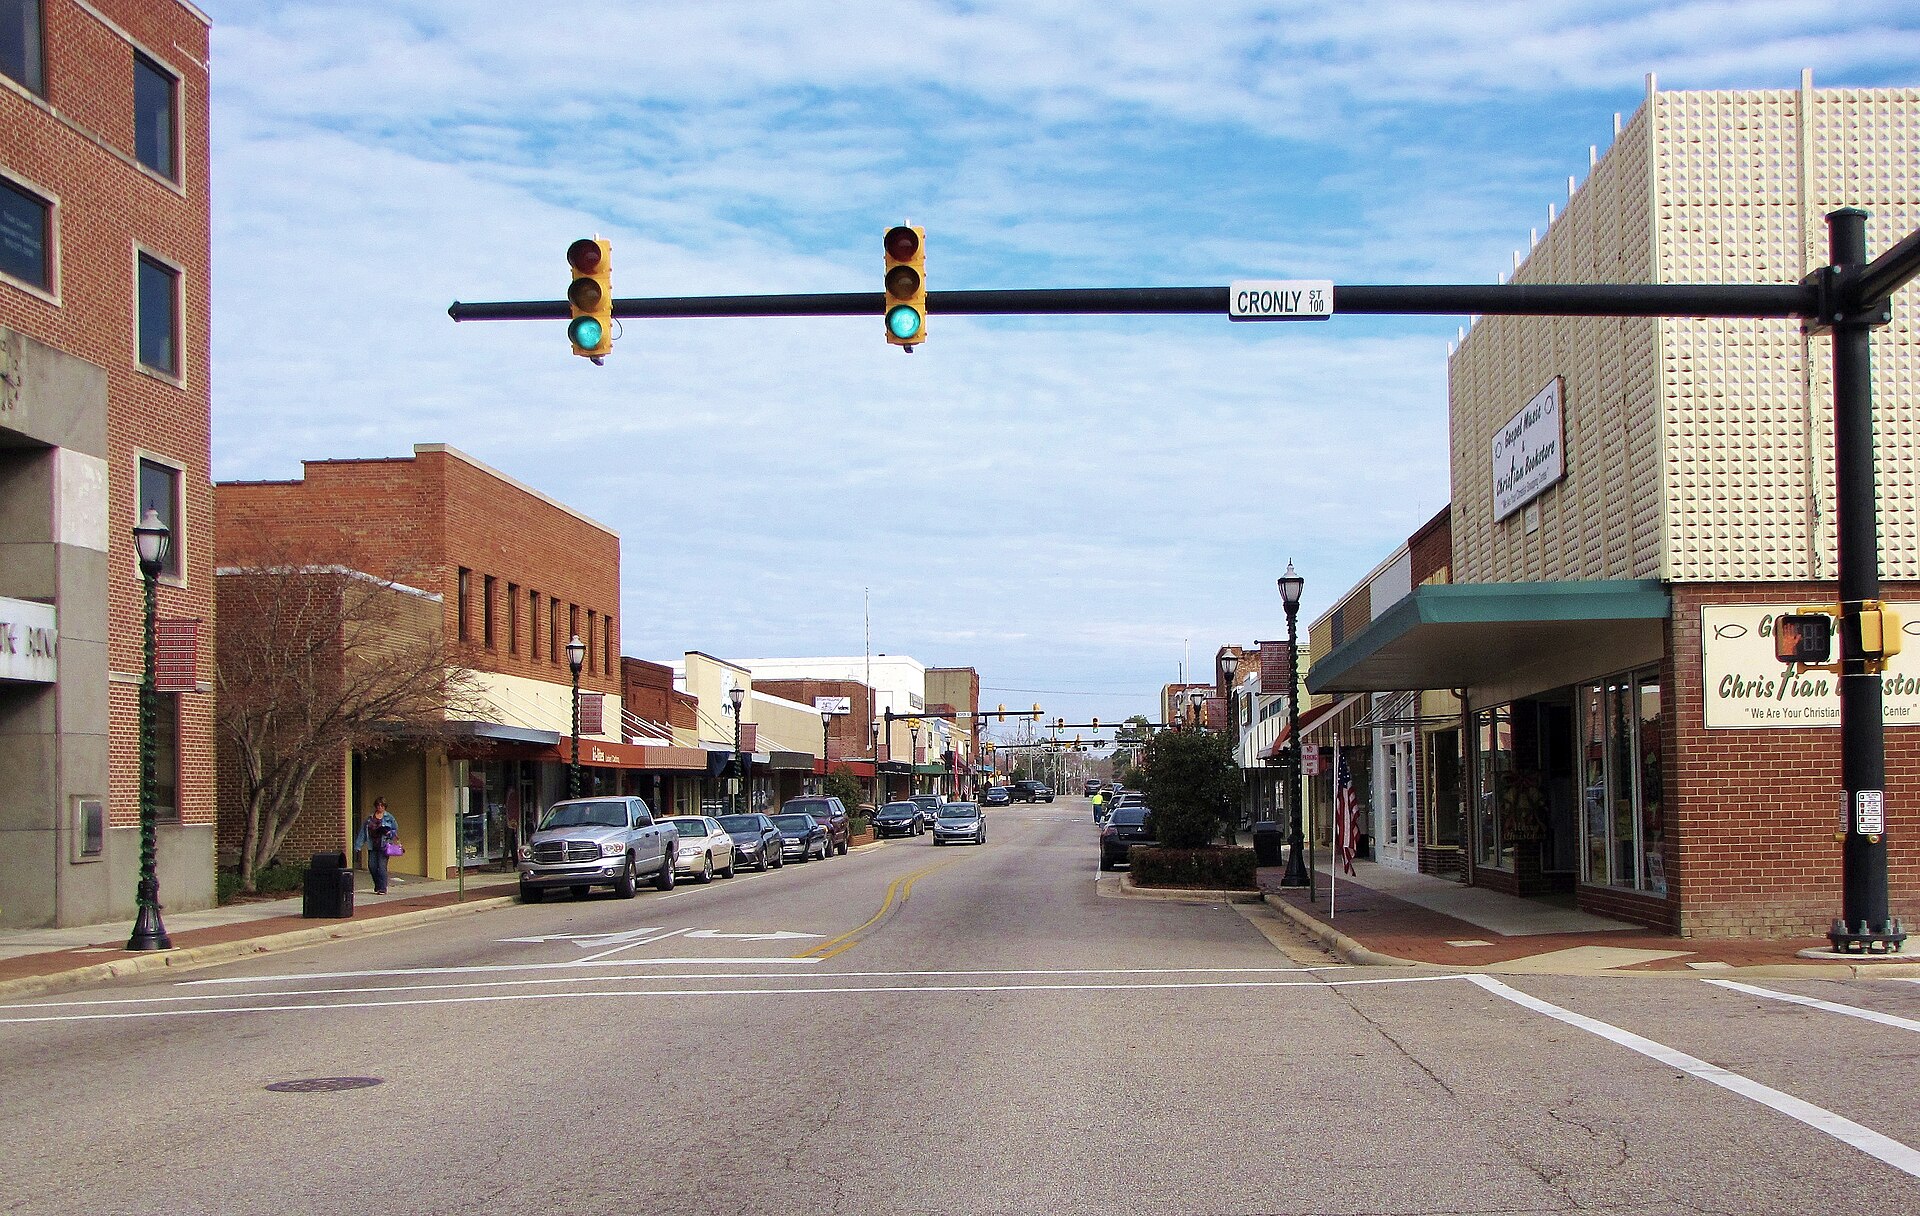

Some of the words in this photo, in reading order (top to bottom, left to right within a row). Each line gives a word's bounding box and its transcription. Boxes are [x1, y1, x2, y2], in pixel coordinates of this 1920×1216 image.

[1237, 290, 1302, 313] CRONLY
[1308, 290, 1323, 300] ST
[1308, 300, 1324, 313] 100
[1504, 417, 1523, 448] Gospel
[1522, 404, 1541, 433] Music
[1496, 455, 1525, 497] Christian
[1524, 440, 1555, 476] Bookstore
[1718, 661, 1829, 702] Christian
[1766, 708, 1781, 718] Are
[1782, 707, 1802, 718] Your
[1803, 706, 1841, 718] Christian
[1883, 705, 1911, 717] Center
